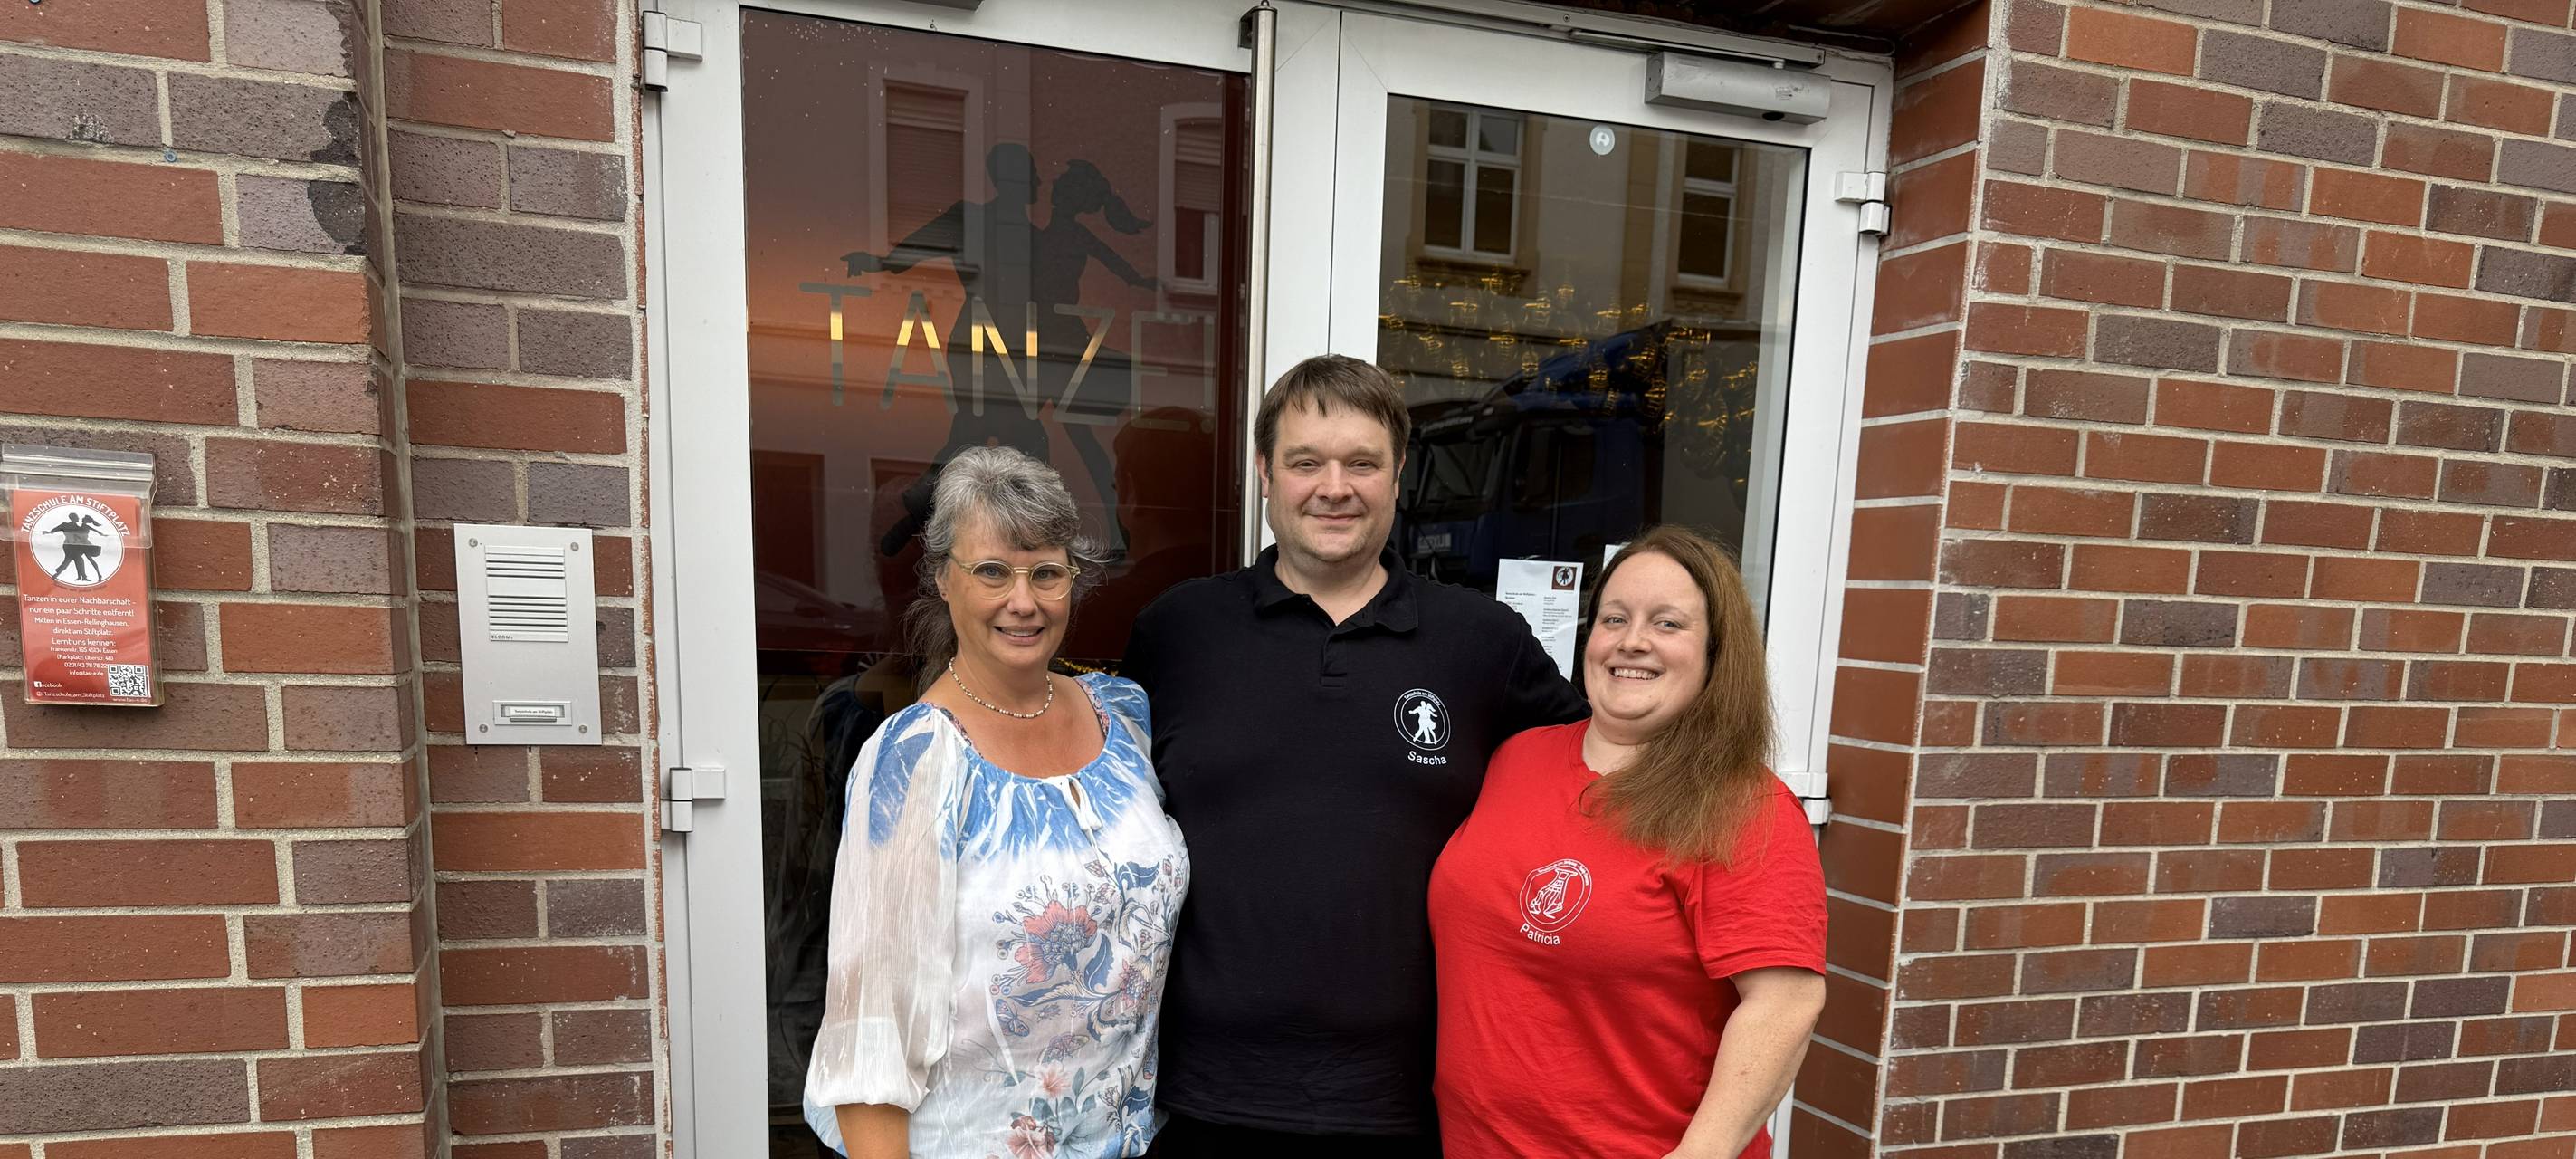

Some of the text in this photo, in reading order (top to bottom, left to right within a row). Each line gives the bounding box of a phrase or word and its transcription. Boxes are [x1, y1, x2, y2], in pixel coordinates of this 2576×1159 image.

[21, 495, 131, 537] TANZSCHULE AM STIFTPLATZ
[24, 594, 50, 603] Tanzen
[80, 597, 131, 606] Nachbarschaft
[73, 608, 101, 616] Schritte
[102, 608, 135, 617] entfernt!
[52, 637, 72, 646] Lernt
[88, 638, 116, 647] kennen:
[1407, 751, 1447, 765] Sascha
[1520, 923, 1560, 945] Patricia
